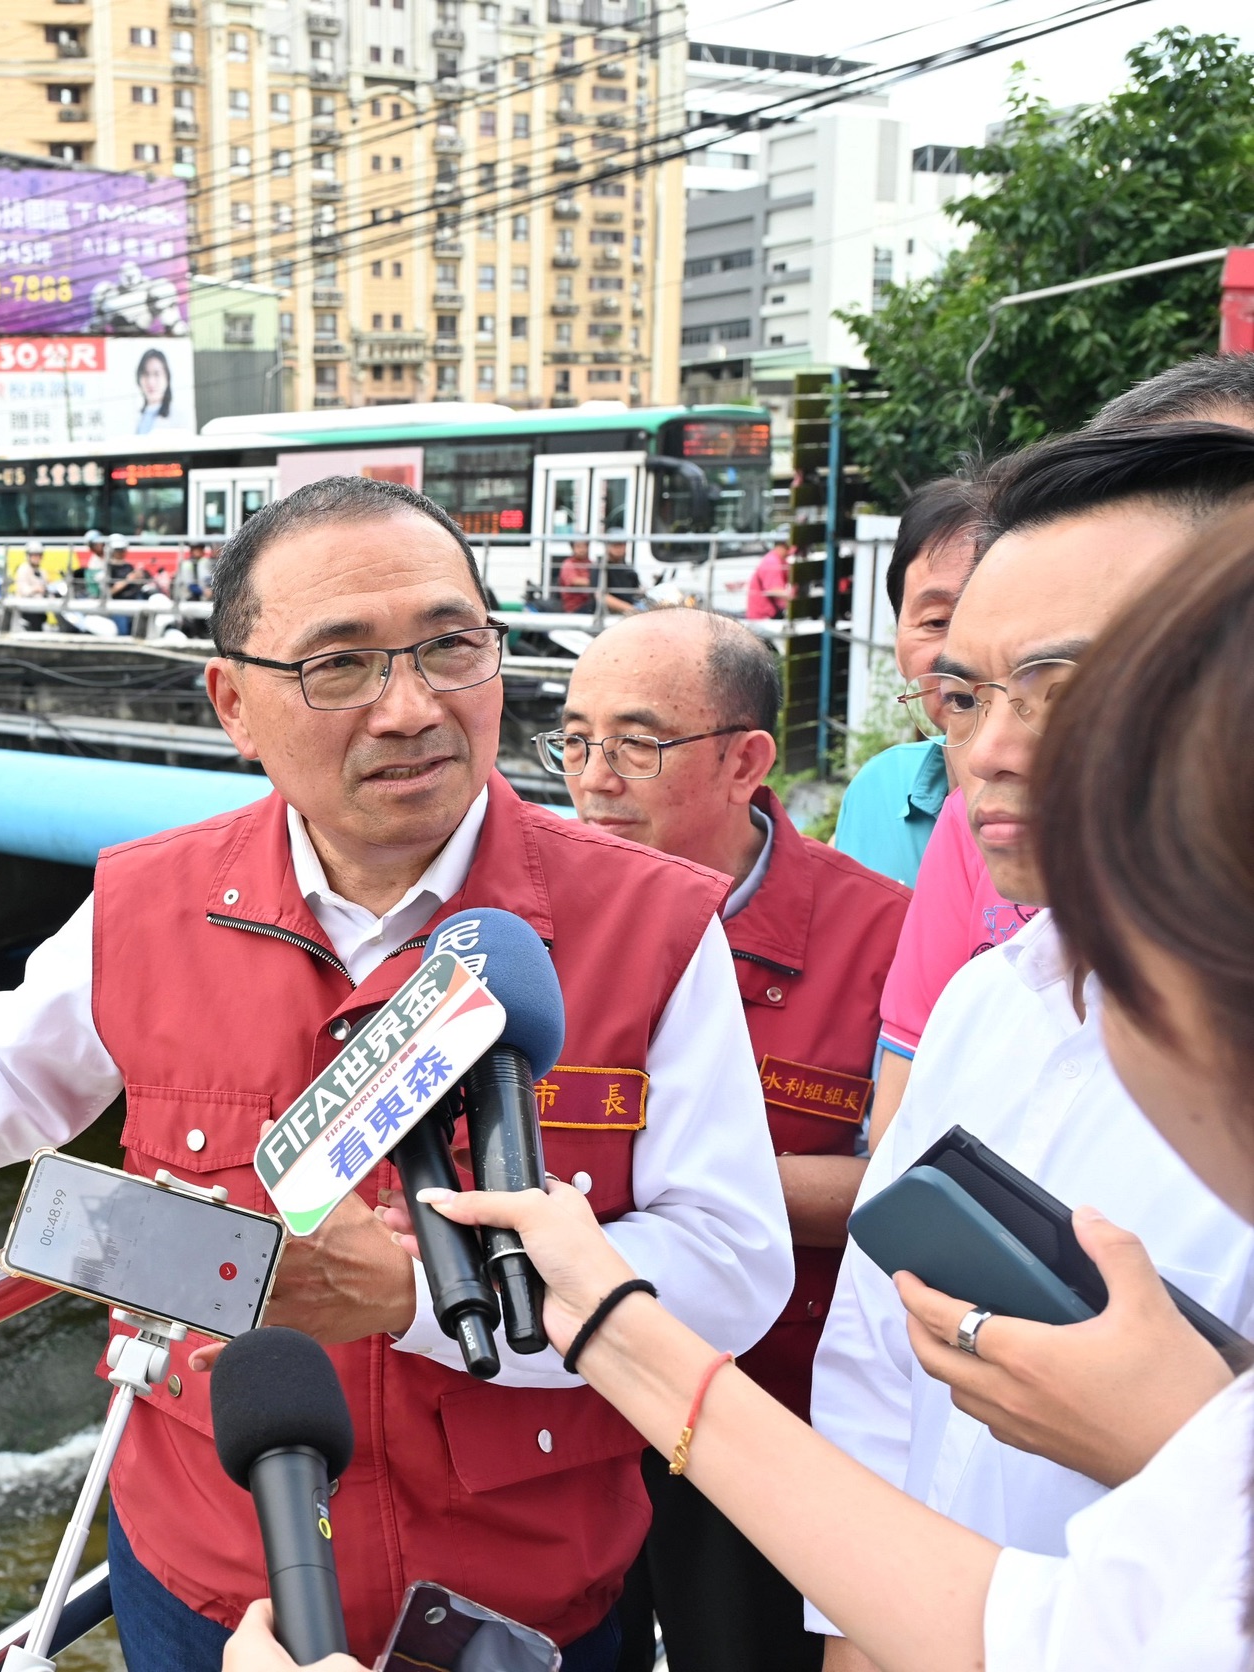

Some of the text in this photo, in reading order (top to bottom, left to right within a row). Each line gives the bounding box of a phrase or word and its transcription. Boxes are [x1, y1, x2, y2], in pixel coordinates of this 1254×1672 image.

[325, 1119, 347, 1142] FIFA
[345, 1083, 379, 1119] WORLD
[379, 1062, 398, 1084] CUP
[327, 1045, 453, 1180] 看東森
[761, 1072, 860, 1111] 水利組組長
[40, 1188, 67, 1246] 00:48.99
[460, 1320, 476, 1350] SONY
